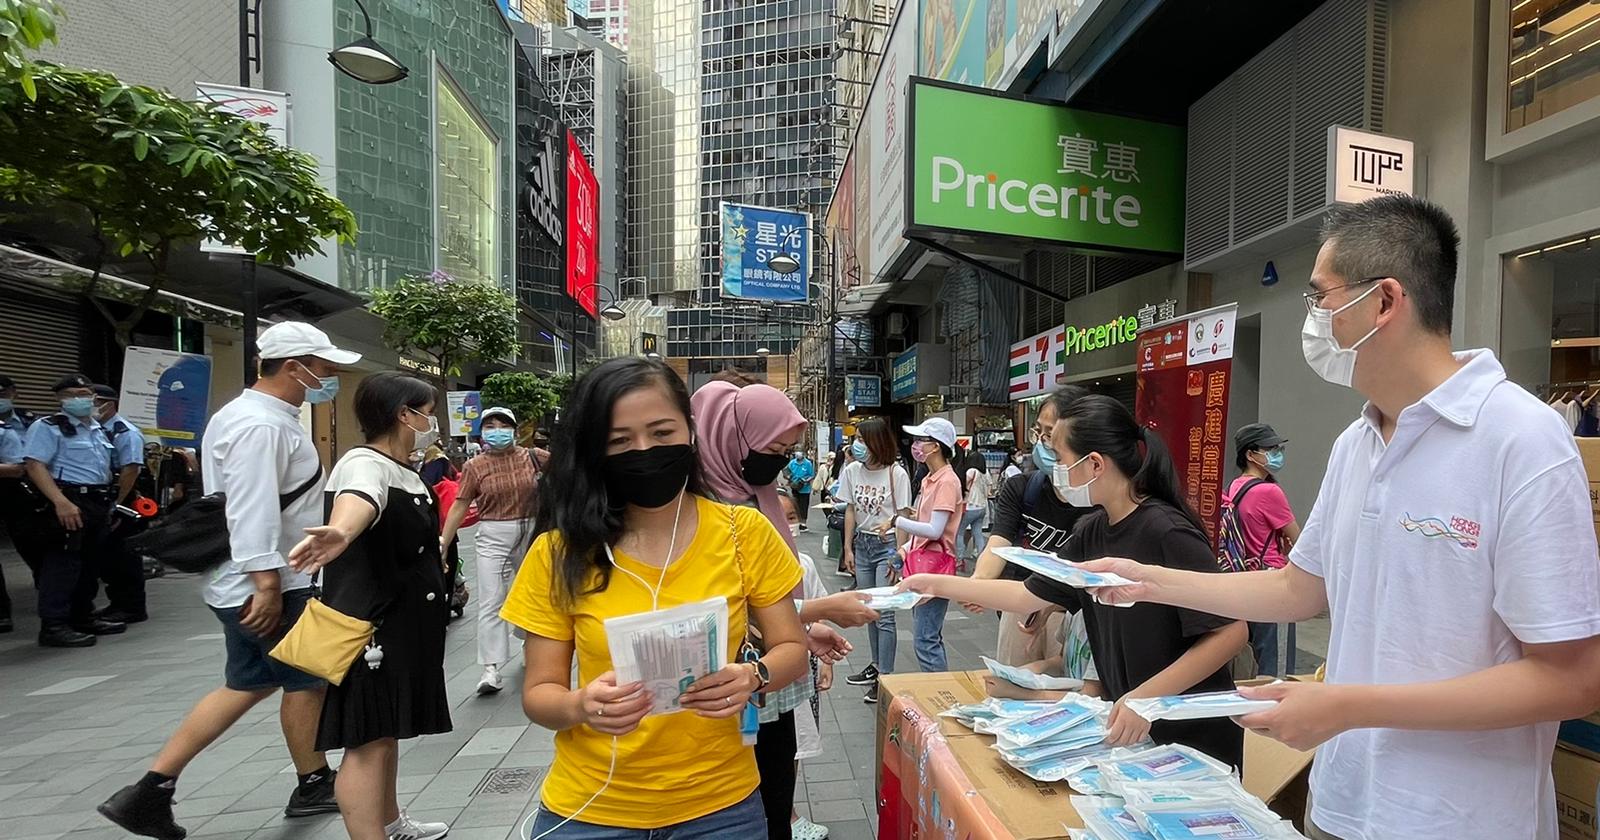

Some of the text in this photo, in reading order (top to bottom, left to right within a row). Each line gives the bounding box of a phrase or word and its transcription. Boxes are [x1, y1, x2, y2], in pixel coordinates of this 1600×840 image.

[1057, 133, 1140, 184] 實惠
[931, 155, 1142, 228] Pricerite
[529, 187, 563, 248] adidas
[755, 221, 802, 249] 星光
[756, 248, 801, 265] STR
[1065, 314, 1138, 357] Pricerite
[1022, 513, 1074, 554] FIL
[1451, 515, 1480, 532] HONG
